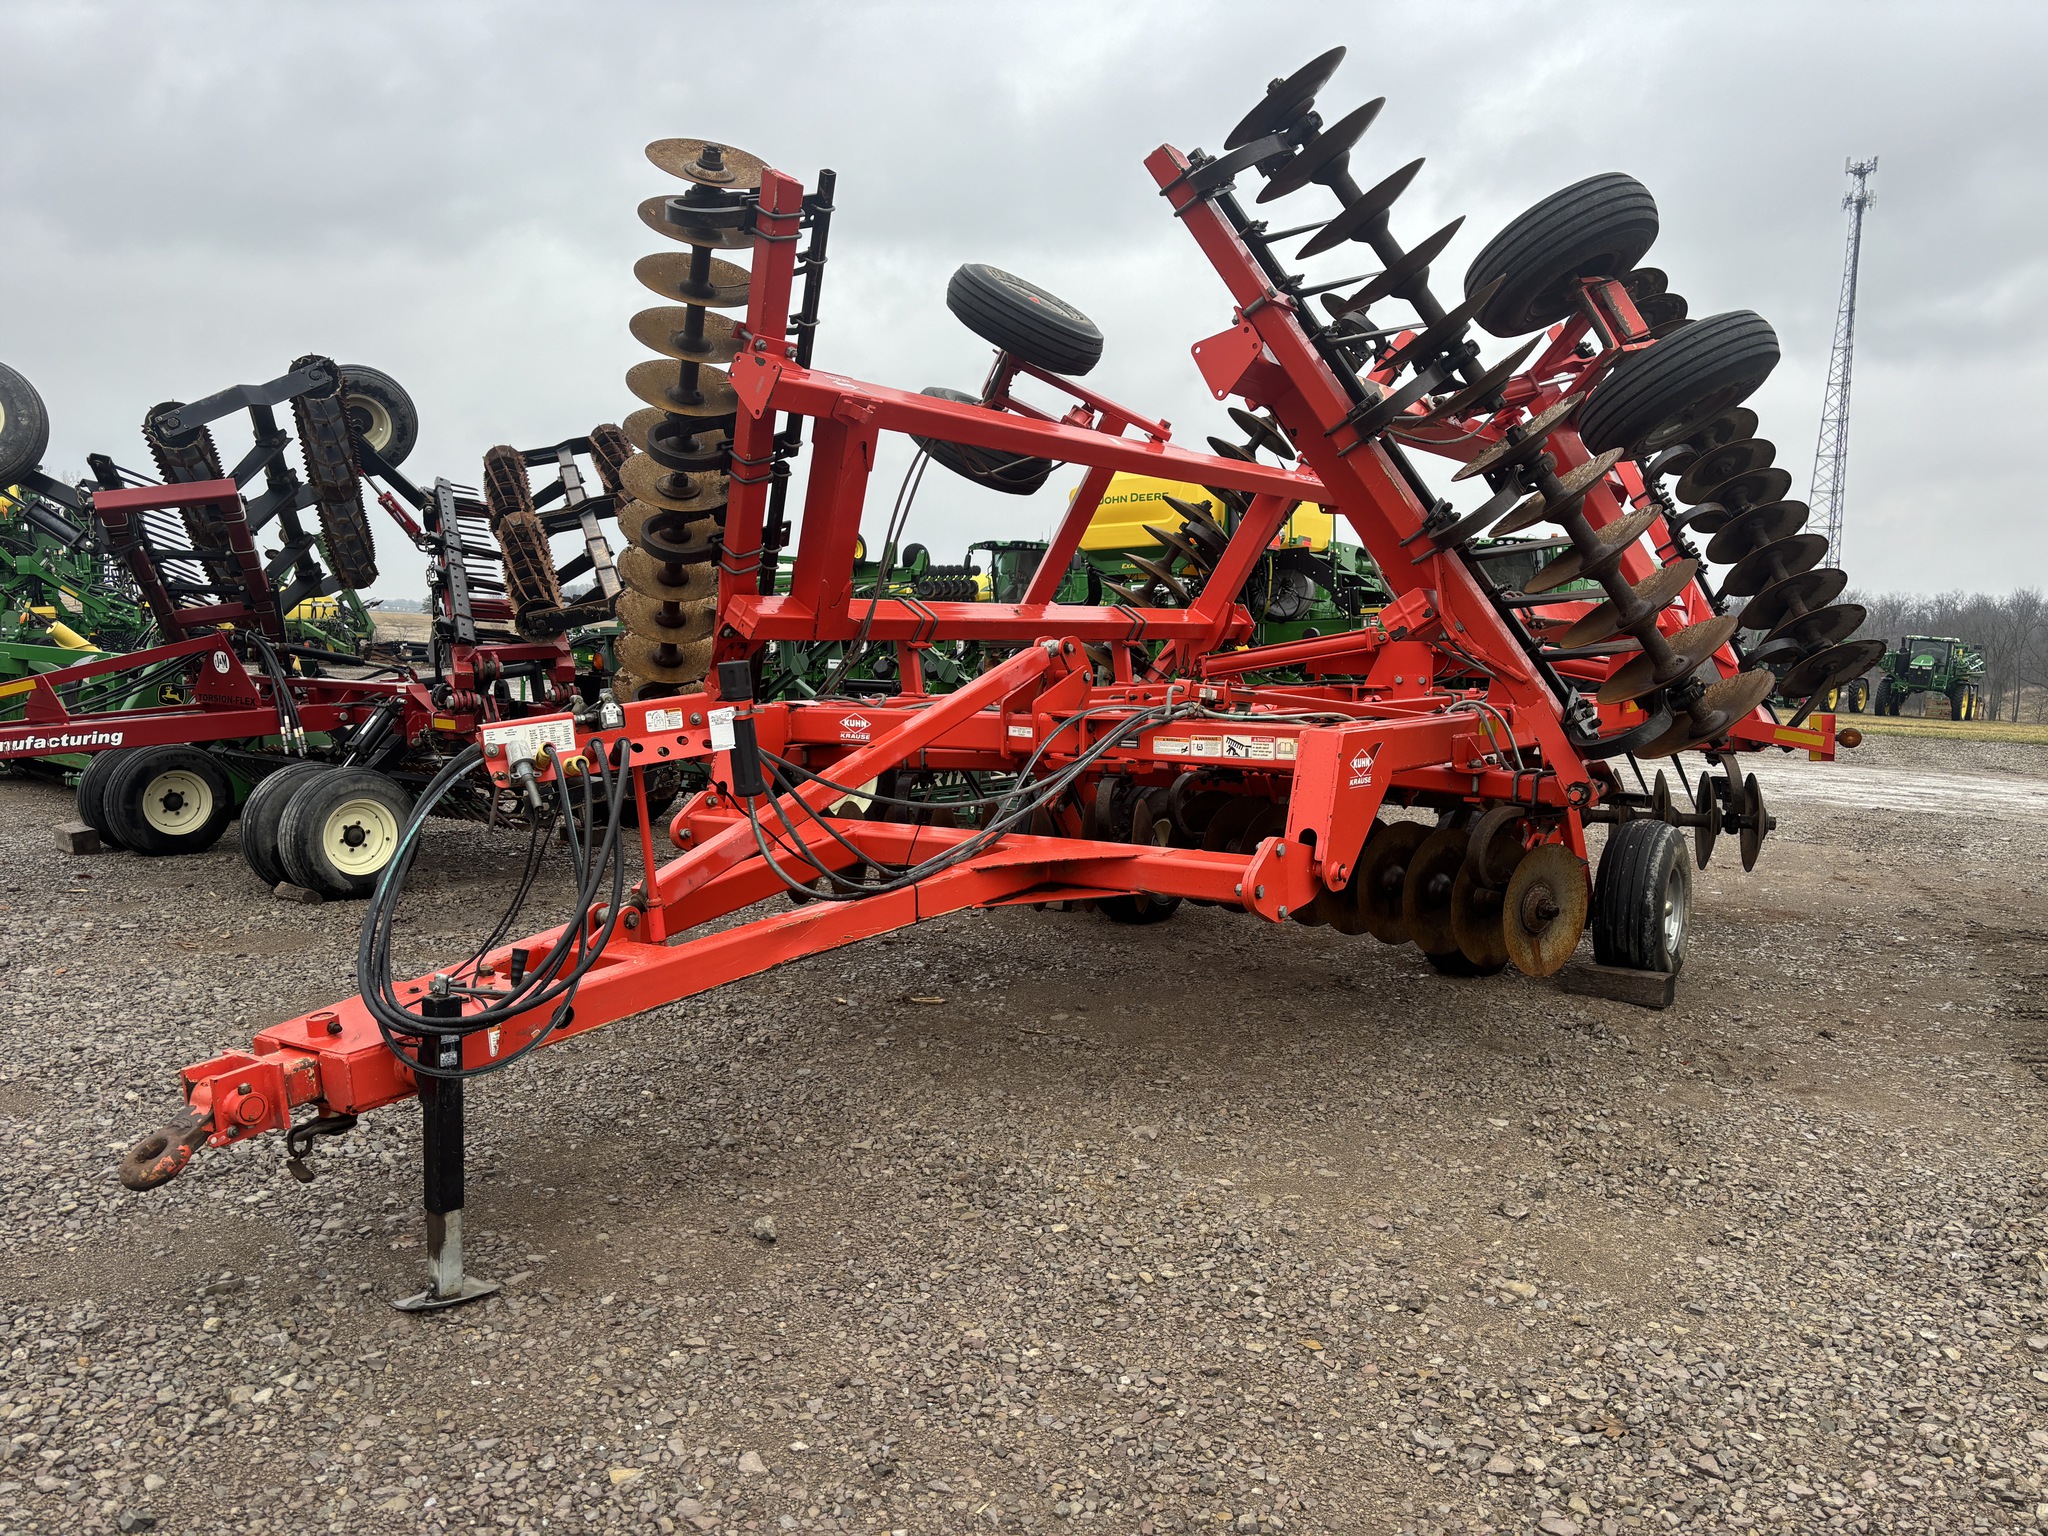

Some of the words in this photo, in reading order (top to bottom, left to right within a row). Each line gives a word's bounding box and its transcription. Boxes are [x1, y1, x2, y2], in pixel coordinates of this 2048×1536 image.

[1100, 494, 1128, 505] JOHN
[198, 693, 256, 706] TORSION-FLEX
[844, 719, 867, 728] KUHN
[1353, 757, 1370, 769] KUHN
[1349, 776, 1371, 786] KRAUSE
